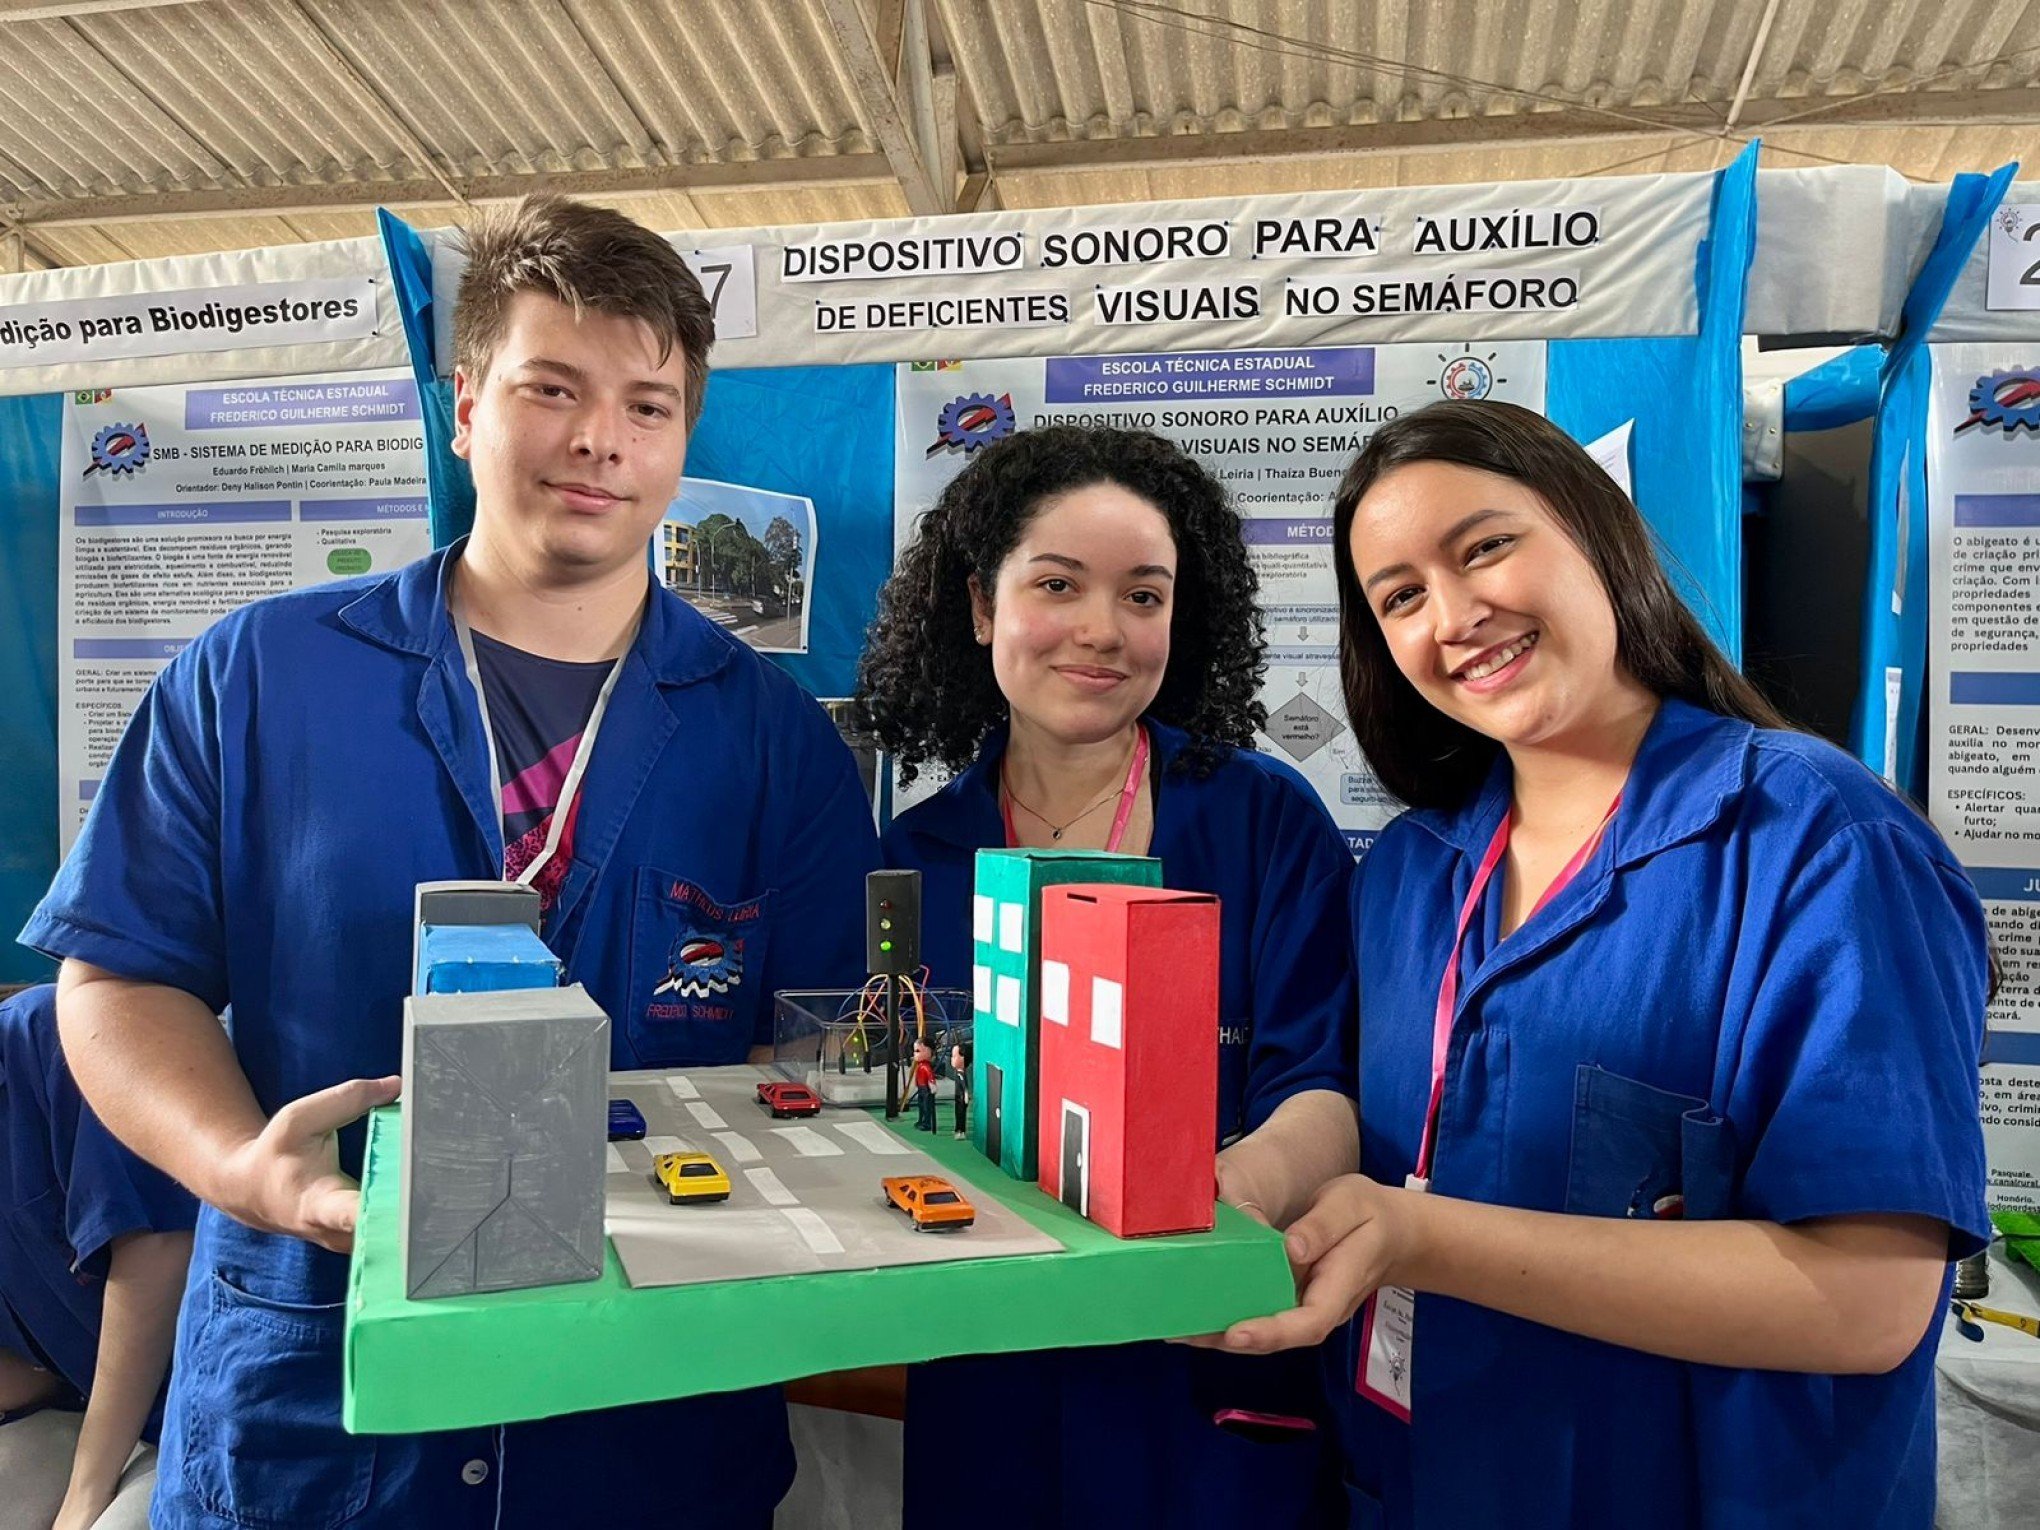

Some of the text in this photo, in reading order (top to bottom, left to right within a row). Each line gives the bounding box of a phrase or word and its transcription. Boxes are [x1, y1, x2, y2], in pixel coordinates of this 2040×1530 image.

[784, 209, 1598, 277] DISPOSITIVO SONORO PARA AUXÍLIO
[701, 264, 732, 319] 7
[817, 274, 1577, 331] DE DEFICIENTES VISUAIS NO SEMÁFORO
[0, 297, 358, 349] dição para Biodigestores
[1103, 356, 1315, 375] ESCOLA TÉCNICA ESTADUAL
[1084, 376, 1334, 396] FREDERICO GUILHERME SCHMIDT
[223, 386, 388, 405] ESCOLA TÉCNICA ESTADUAL
[210, 403, 405, 423] FREDERICO GUILHERME SCHMIDT
[1034, 404, 1399, 429] DISPOSITIVO SONORO PARA AUXÍLIO
[153, 449, 180, 461] SMB
[190, 445, 246, 459] SISTEMA
[250, 444, 267, 456] DE
[271, 439, 333, 457] MEDIÇÃO
[336, 439, 373, 452] PARA
[377, 437, 423, 451] BIODIG
[1181, 438, 1260, 455] VISUAIS
[1267, 437, 1296, 453] NO
[213, 466, 248, 476] Eduardo
[291, 464, 315, 473] Maria
[316, 462, 346, 472] Camila
[348, 463, 385, 473] marques
[1220, 468, 1253, 479] Leiria
[175, 484, 219, 493] Orientador:
[221, 482, 242, 492] Deny
[276, 480, 302, 489] Pontin
[309, 478, 367, 489] Coorientação:
[369, 477, 392, 486] Paula
[1237, 492, 1324, 503] Coorientação:
[157, 509, 208, 519] INTRODUÇÃO
[1953, 537, 1962, 546] O
[1966, 536, 2018, 548] abigeato
[1953, 550, 1967, 559] de
[1973, 550, 2017, 562] criação
[1953, 564, 1985, 572] crime
[1990, 565, 2013, 575] que
[1952, 576, 2030, 588] criação. Com
[1952, 589, 2031, 601] propriedades
[1952, 603, 2032, 614] componentes
[1972, 615, 2019, 628] questão
[2023, 615, 2038, 624] de
[1951, 628, 2039, 640] de segurança,
[1951, 641, 2028, 652] propriedades
[1949, 725, 1989, 735] GERAL:
[1948, 738, 1984, 748] auxilia
[1992, 740, 2007, 748] no
[1948, 750, 2030, 763] abigeato, em
[1948, 764, 2036, 777] quando alguém
[1948, 788, 2026, 801] ESPECÍFICOS:
[1964, 804, 2005, 814] Alertar
[1964, 816, 1997, 827] furto;
[1963, 829, 2001, 841] Ajudar
[2004, 832, 2020, 840] no
[1992, 906, 2007, 916] de
[1998, 932, 2032, 942] crime
[2002, 960, 2020, 969] em
[2001, 985, 2029, 995] terra
[2020, 998, 2034, 1008] de
[1994, 1092, 2012, 1100] em
